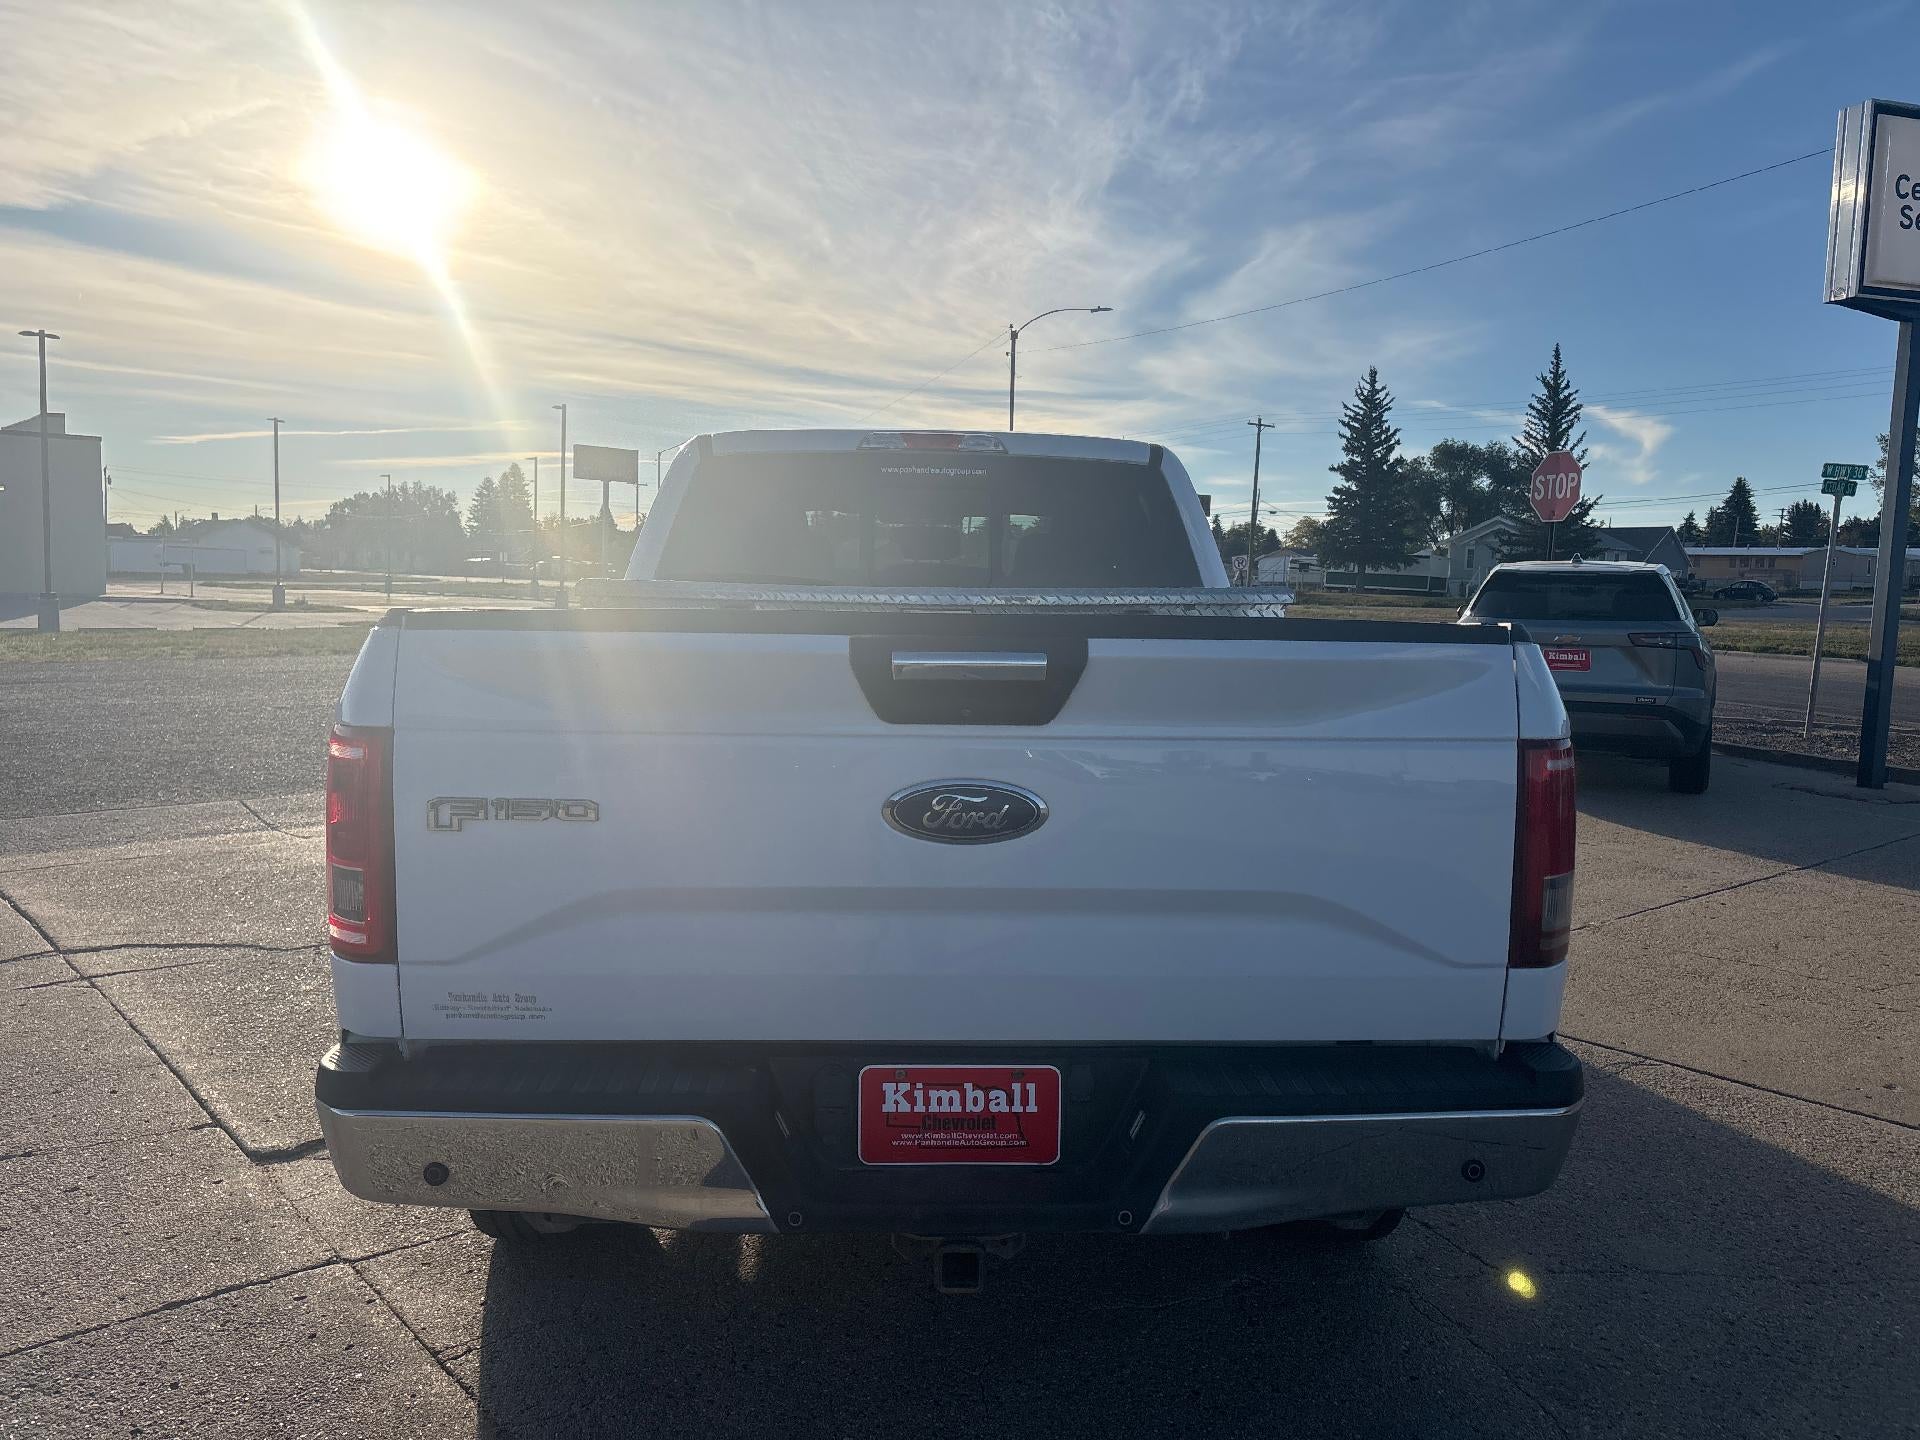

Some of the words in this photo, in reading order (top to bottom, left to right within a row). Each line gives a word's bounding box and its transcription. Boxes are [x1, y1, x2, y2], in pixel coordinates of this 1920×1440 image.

[1853, 466, 1864, 479] 30
[1534, 472, 1579, 501] STOP
[1548, 651, 1586, 661] Kimball
[922, 794, 1010, 829] Ford
[881, 1082, 1038, 1113] Kimball
[921, 1114, 997, 1131] Chevrolet
[891, 1139, 1027, 1147] www.PanhandleAutoGroup.com
[901, 1132, 1018, 1140] www.KimballChevrolet.com
